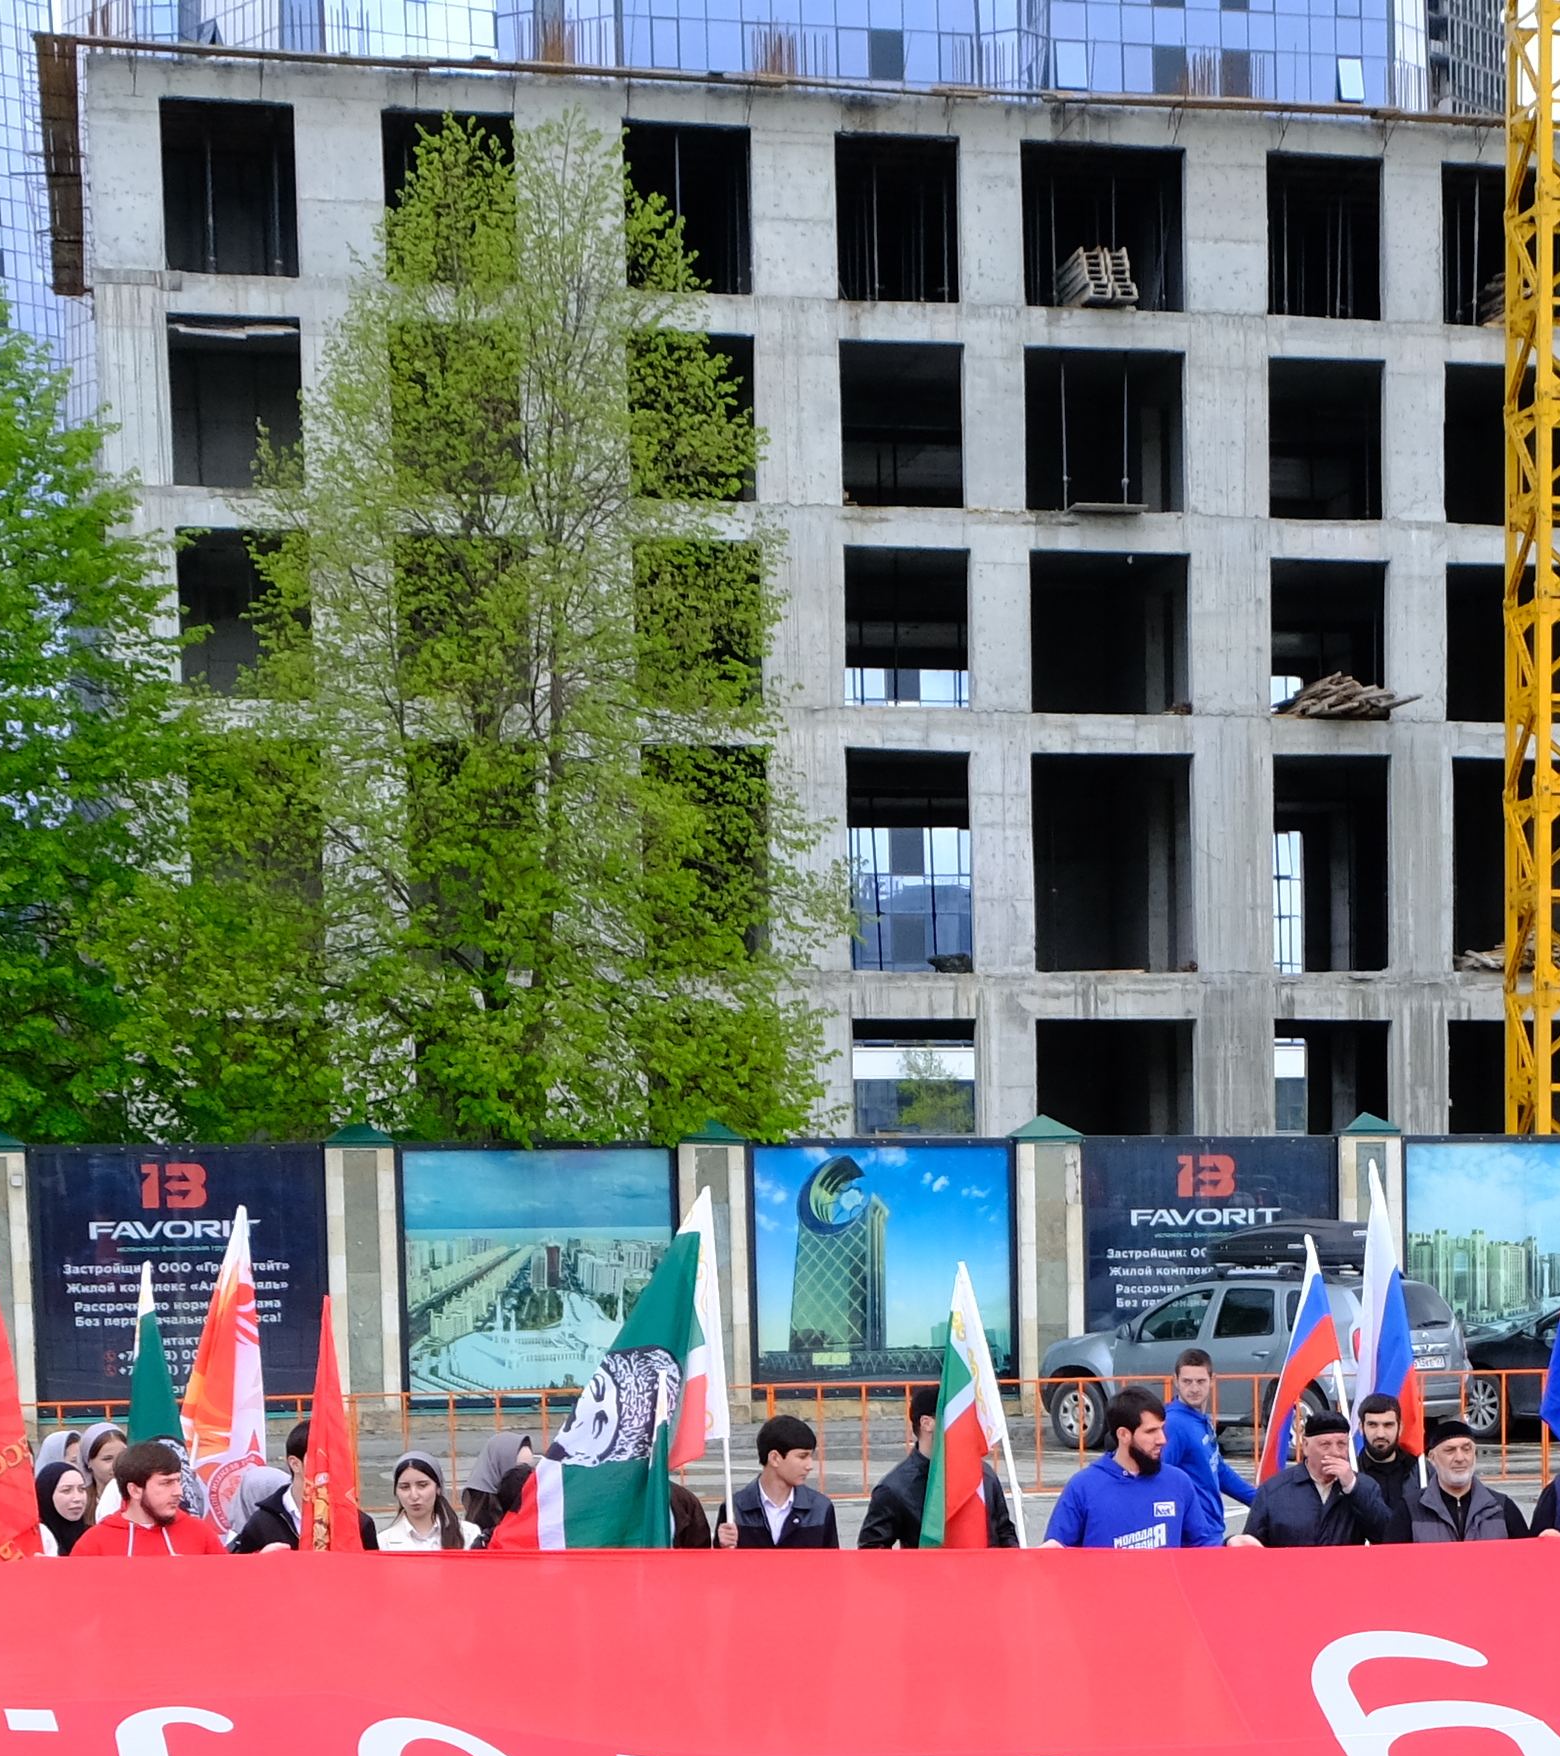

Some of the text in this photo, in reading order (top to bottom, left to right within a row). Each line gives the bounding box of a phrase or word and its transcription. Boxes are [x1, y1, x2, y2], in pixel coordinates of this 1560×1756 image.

[1130, 1207, 1282, 1226] FAVORIT
[1106, 1248, 1187, 1260] Застройщик:
[159, 1262, 192, 1273] ООО
[1109, 1266, 1153, 1277] Жилой
[66, 1282, 116, 1294] Жилой
[74, 1302, 139, 1314] Рассрочк
[75, 1316, 100, 1327] Без
